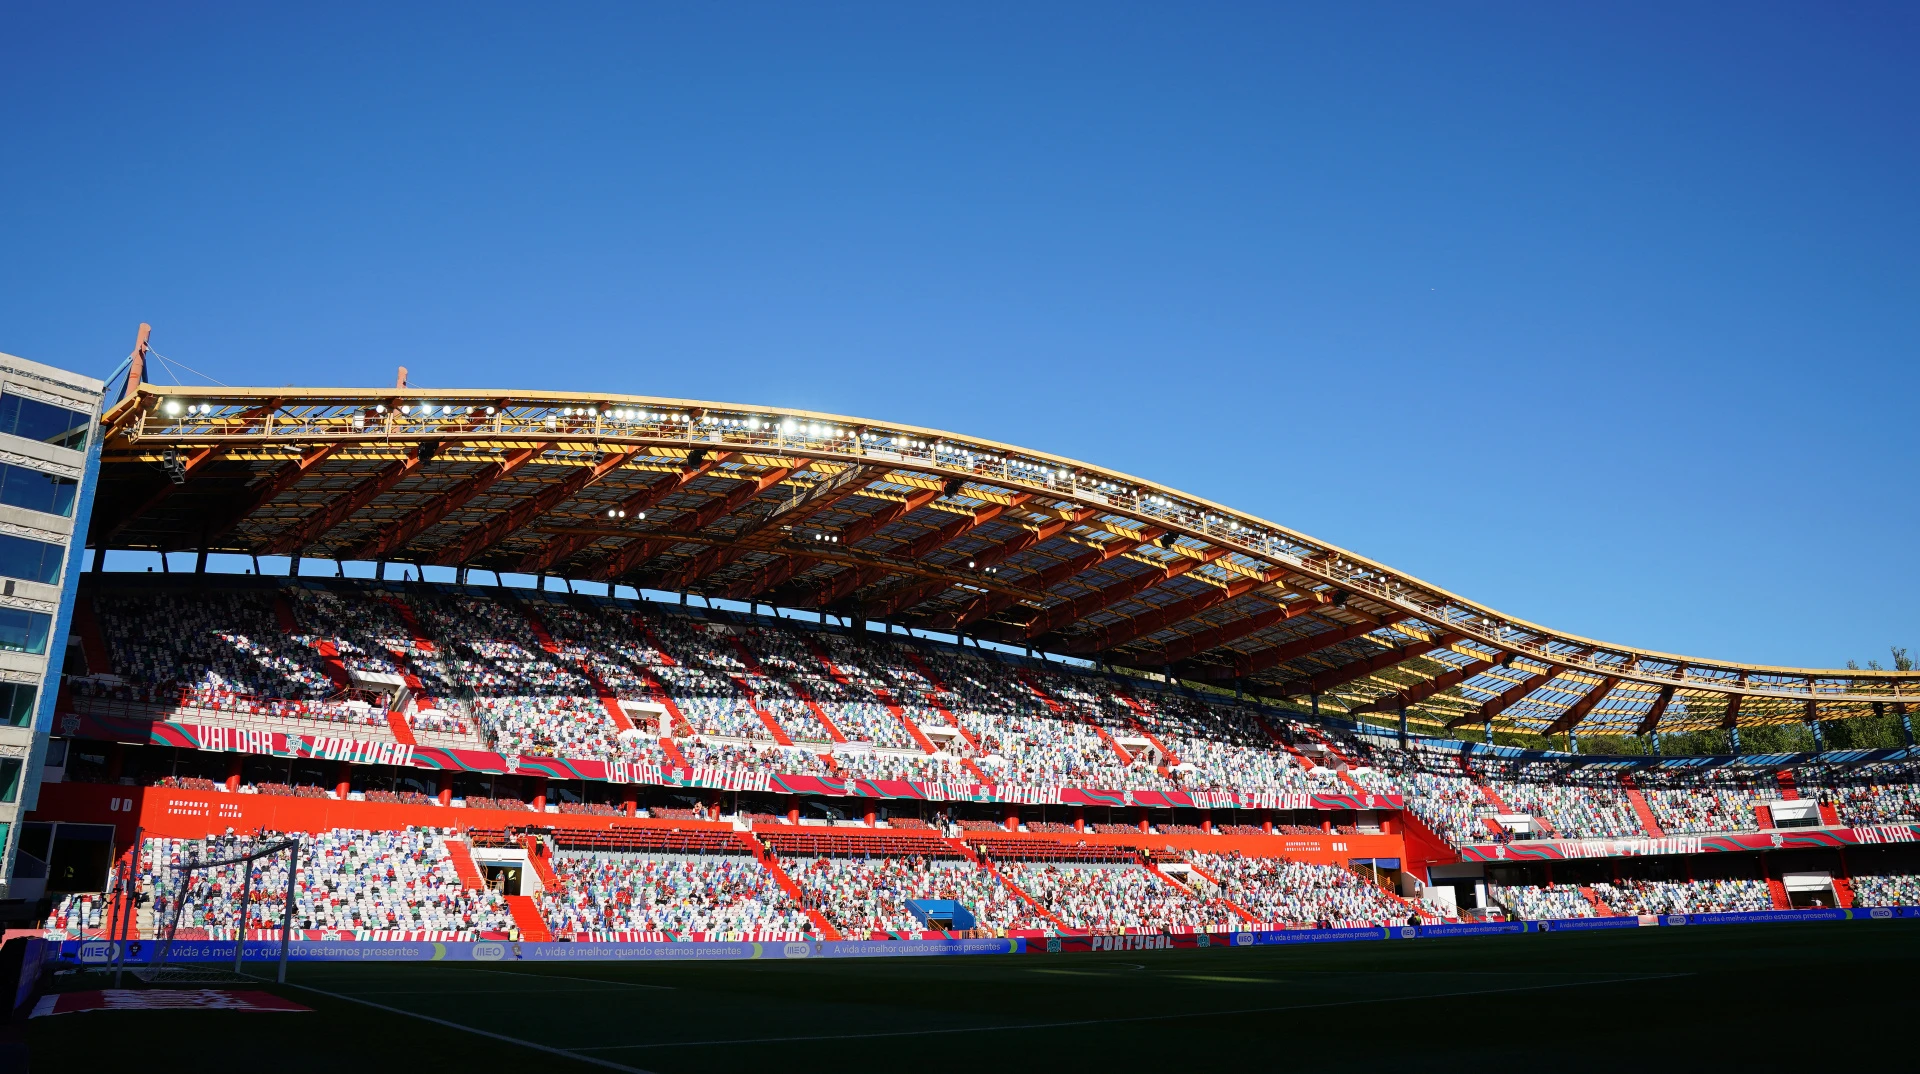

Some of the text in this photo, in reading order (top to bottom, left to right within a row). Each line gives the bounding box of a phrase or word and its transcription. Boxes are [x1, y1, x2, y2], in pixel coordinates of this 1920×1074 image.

[198, 725, 415, 766] VAI DAR PORTUGAL
[603, 761, 773, 791] VAI DAR PORTUGAL
[948, 783, 972, 801] DAR
[995, 784, 1064, 804] PORTUGAL
[1211, 791, 1234, 808] DAR
[1253, 793, 1314, 808] PORTUGAL
[169, 800, 208, 808] DESPORTO
[168, 808, 201, 816] FUTEBOL
[1881, 825, 1915, 843] DAR
[1332, 842, 1348, 852] UDL
[1582, 842, 1609, 858] DAR
[1630, 837, 1706, 856] PORTUGAL
[1749, 914, 1773, 922] quando
[1803, 912, 1837, 920] presentes
[1275, 933, 1286, 941] vida
[1291, 932, 1310, 940] melhor
[1311, 932, 1331, 941] quando
[1355, 931, 1379, 939] presentes
[834, 943, 1001, 954] A vida é melhor quando estamos presentes
[1091, 935, 1174, 951] PORTUGAL
[172, 945, 199, 956] vida
[202, 945, 210, 956] é
[310, 946, 360, 956] estamos
[362, 947, 419, 958] presentes
[534, 946, 741, 958] A vida é melhor quando estamos presentes
